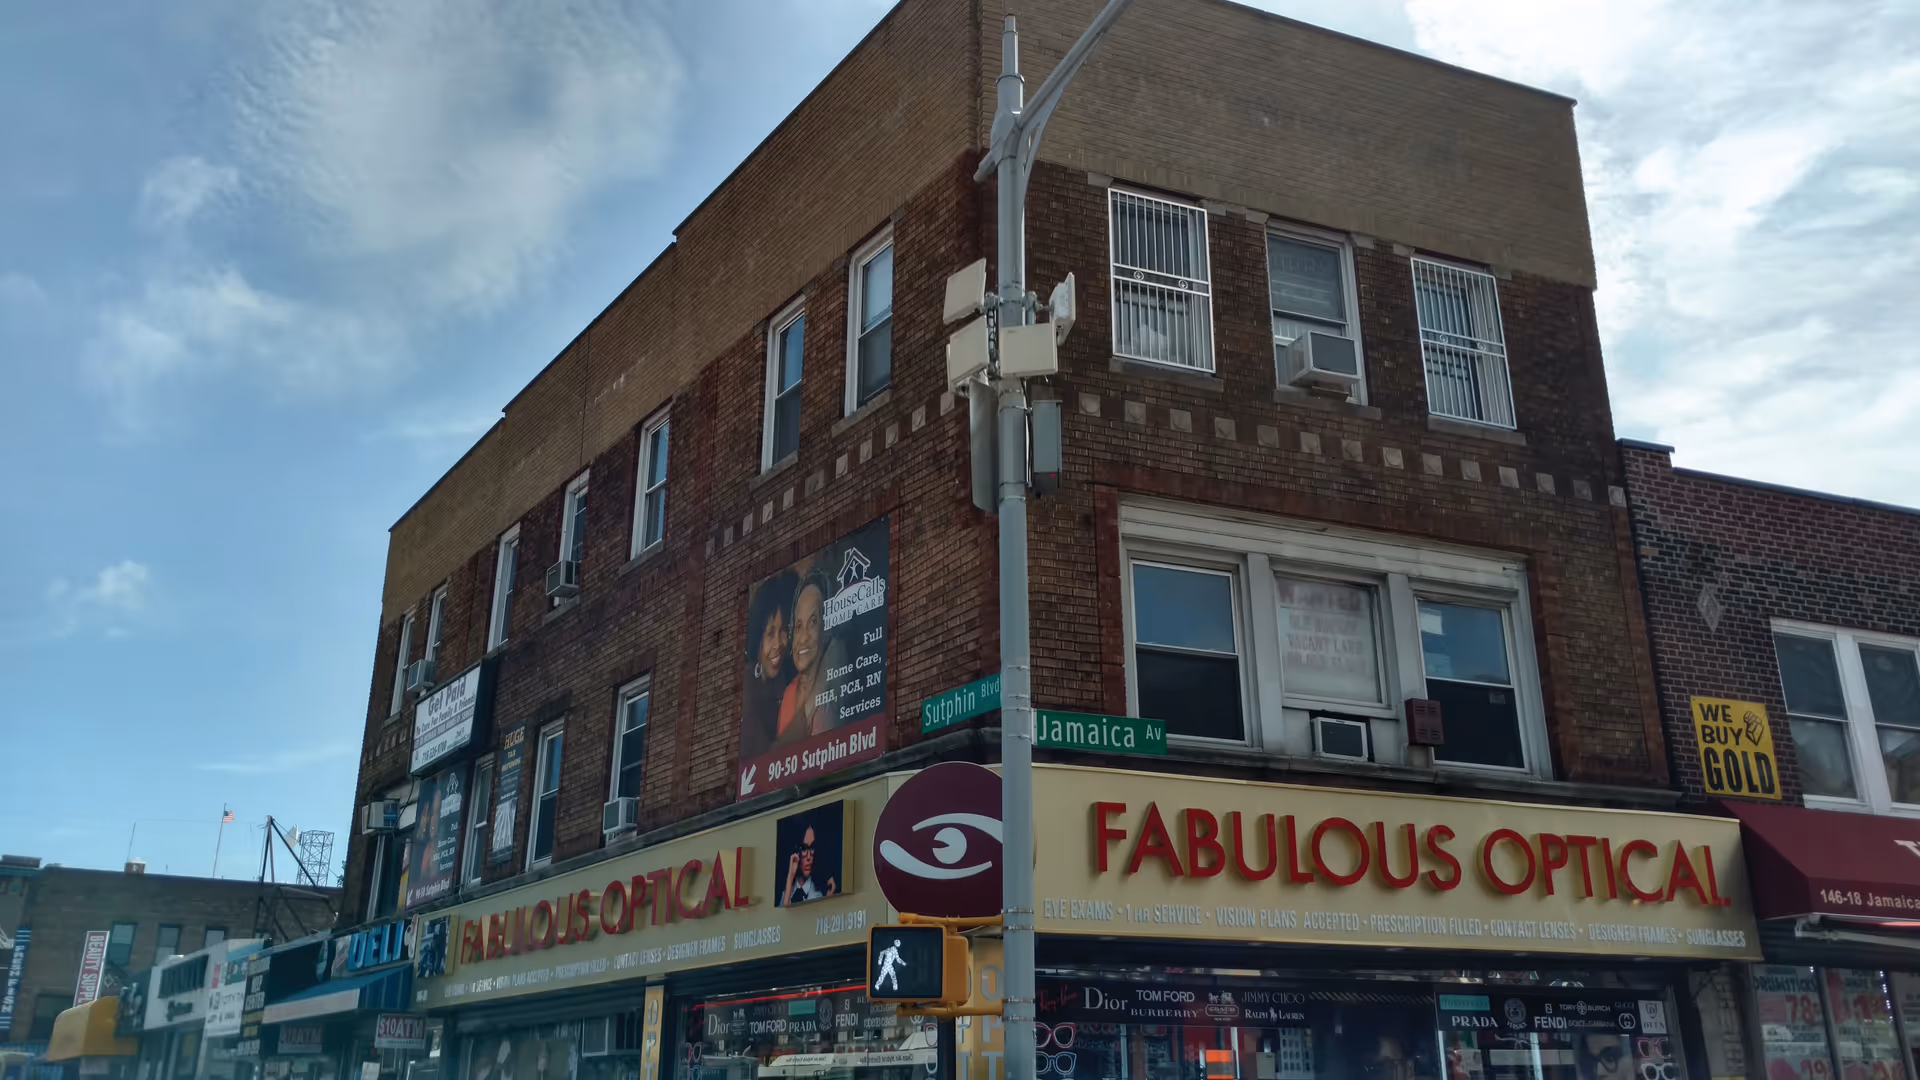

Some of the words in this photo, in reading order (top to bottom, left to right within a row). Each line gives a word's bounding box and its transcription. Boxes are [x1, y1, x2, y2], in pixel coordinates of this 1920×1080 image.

[823, 575, 886, 614] HouseCalls
[823, 608, 853, 631] HOME
[857, 594, 884, 616] CARE
[862, 627, 883, 646] Full
[826, 661, 854, 682] Home
[856, 650, 882, 670] Care,
[428, 690, 444, 717] Get
[445, 676, 467, 706] Paid
[814, 686, 838, 708] HHA,
[840, 679, 863, 698] PCA,
[866, 671, 882, 687] RN
[924, 690, 976, 727] Sutphin
[981, 677, 1000, 699] Blvd
[839, 695, 881, 720] Services
[1698, 703, 1734, 723] WE
[504, 726, 526, 750] HUGE
[1038, 714, 1136, 749] Jamaica
[1145, 723, 1162, 741] Av
[1700, 724, 1744, 746] BUY
[768, 755, 798, 782] 90-50
[801, 739, 847, 771] Sutphin
[849, 726, 877, 755] Blvd
[1703, 746, 1776, 795] GOLD
[1094, 801, 1463, 892] FABULOUS
[1482, 827, 1732, 908] OPTICAL
[459, 888, 591, 965] FABULOUS
[599, 846, 750, 936] OPTICAL
[1820, 888, 1862, 906] 146-18
[1866, 892, 1920, 910] Jamaica
[815, 909, 868, 936] 718-291-9191
[1043, 897, 1068, 920] EYE
[1070, 899, 1114, 922] EXAMS
[1126, 903, 1132, 922] 1
[1134, 907, 1151, 921] HR
[1153, 904, 1202, 925] SERVICE
[1215, 906, 1256, 927] VISION
[1259, 908, 1297, 929] PLANS
[1303, 911, 1361, 932] ACCEPTED
[1370, 914, 1447, 935] PRESCRIPTION
[1450, 917, 1482, 937] FILLED
[1490, 918, 1538, 939] CONTACT
[1539, 920, 1577, 940] LENSES
[1588, 922, 1637, 944] DESIGNER
[1637, 925, 1678, 945] FRAMES
[1685, 929, 1747, 949] SUNGLASSES
[84, 934, 105, 970] BEAUTY
[348, 919, 405, 972] DELI
[613, 950, 639, 971] CONTACT
[640, 947, 662, 966] LENSES
[666, 940, 699, 962] DESIGNER
[699, 935, 726, 956] FRAMES
[733, 924, 781, 950] SUNGLASSES
[77, 973, 98, 1004] SUPPL
[1081, 986, 1129, 1010] Dior
[1135, 989, 1161, 1002] TOM
[1163, 990, 1196, 1003] FORD
[1241, 991, 1270, 1004] JIMMY
[1272, 992, 1305, 1004] CHOO
[1130, 1008, 1200, 1019] BURBERRY
[1451, 1015, 1498, 1027] PRADA
[1534, 1015, 1567, 1029] FENDI
[1559, 1003, 1576, 1011] TORY
[1587, 1004, 1611, 1012] BURCH
[395, 1018, 424, 1038] ATM
[707, 1013, 730, 1036] Dior
[749, 1020, 766, 1035] TOM
[766, 1018, 787, 1033] FORD
[788, 1019, 818, 1033] PRADA
[835, 1012, 859, 1027] FENDI
